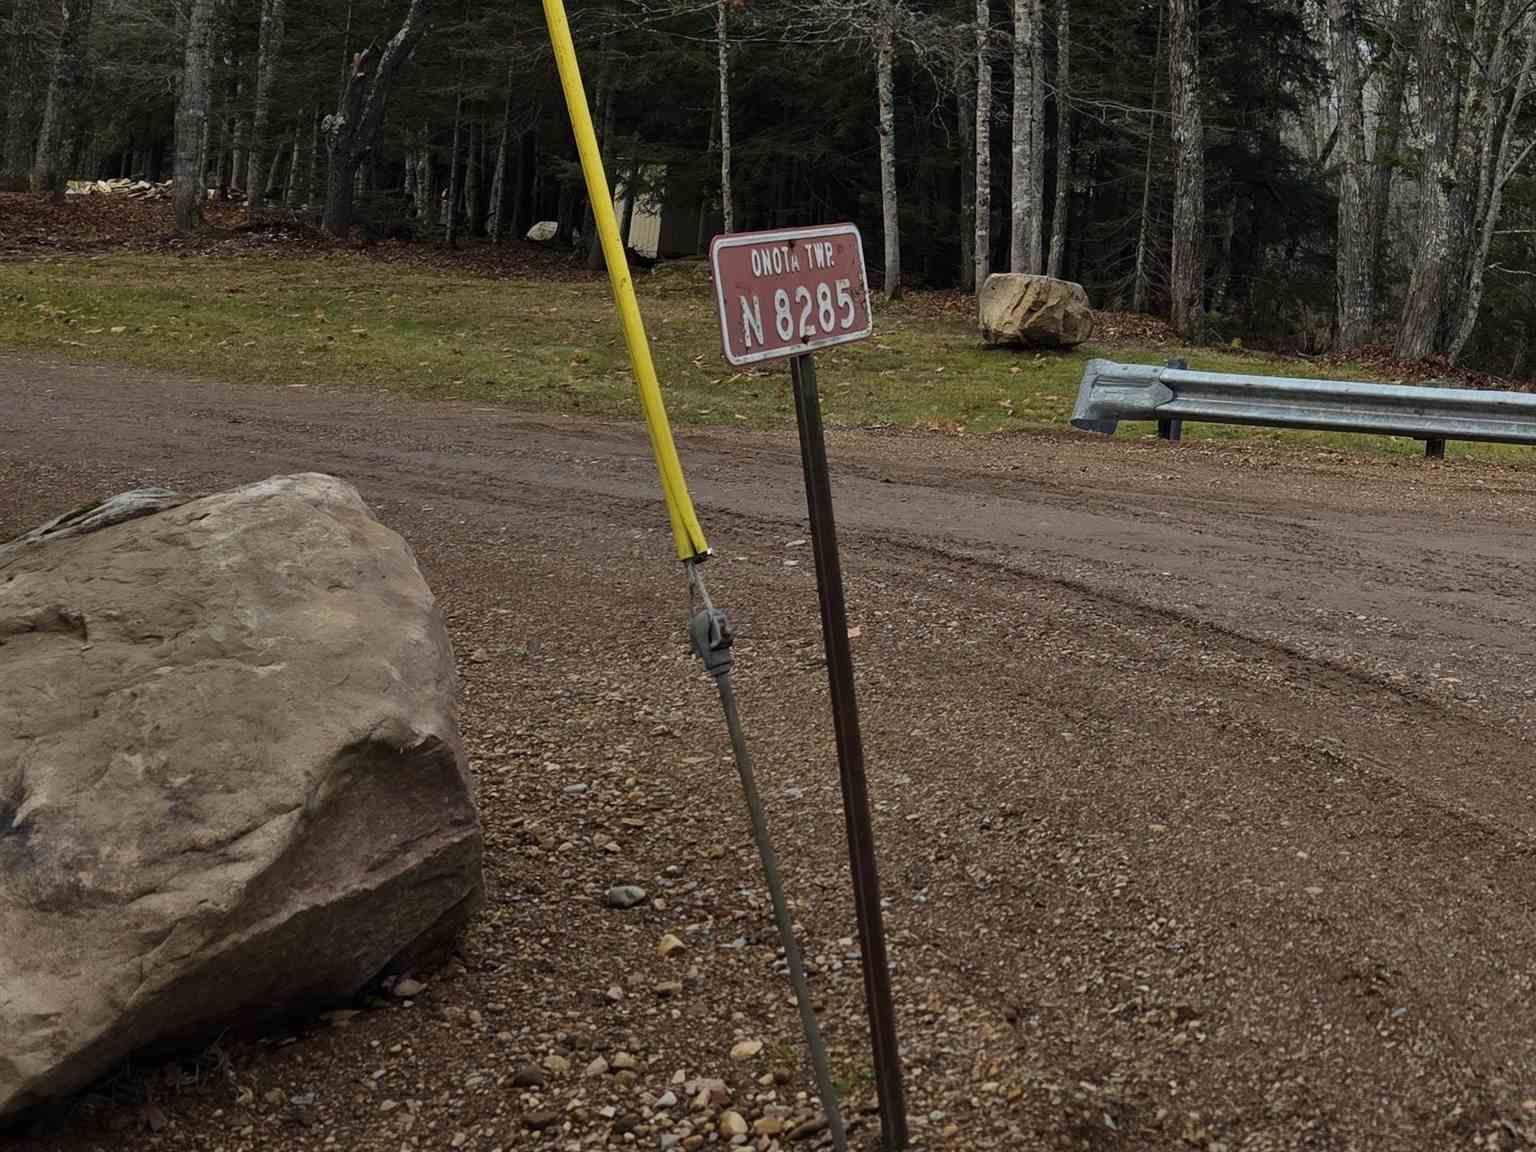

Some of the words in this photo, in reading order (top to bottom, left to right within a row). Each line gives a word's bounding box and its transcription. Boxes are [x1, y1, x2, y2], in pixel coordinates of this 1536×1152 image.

[805, 242, 835, 270] TWP.
[740, 295, 764, 348] N
[774, 278, 855, 341] 8285
